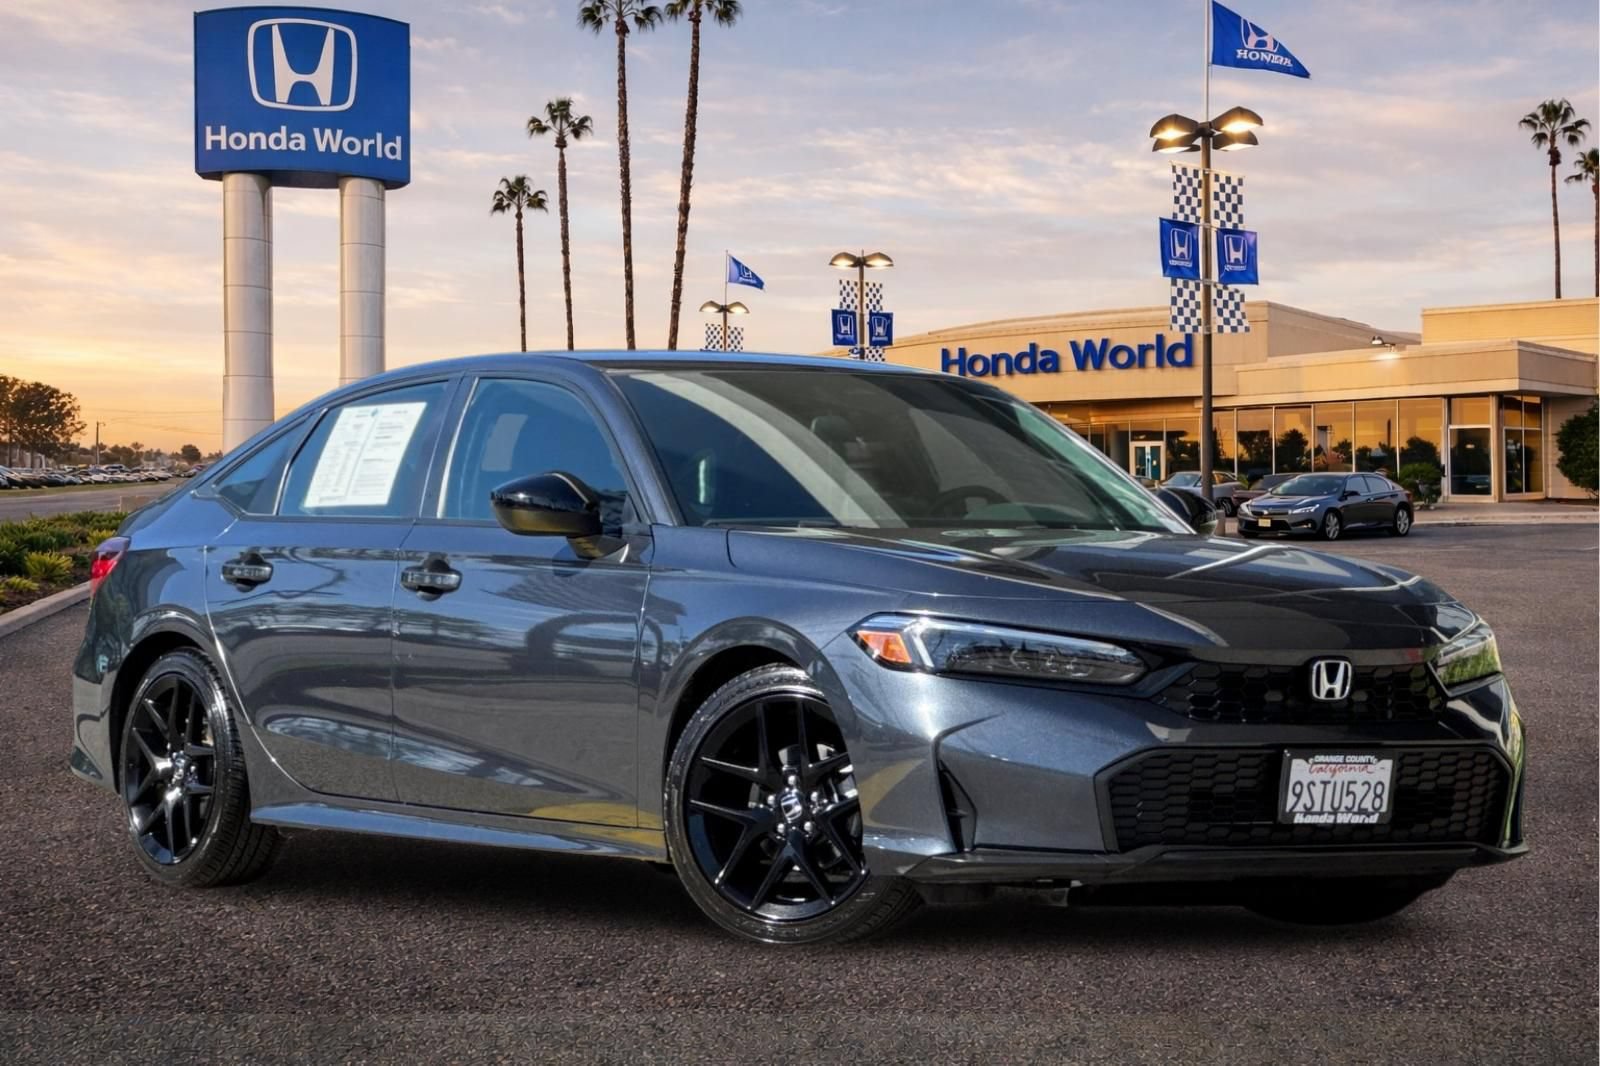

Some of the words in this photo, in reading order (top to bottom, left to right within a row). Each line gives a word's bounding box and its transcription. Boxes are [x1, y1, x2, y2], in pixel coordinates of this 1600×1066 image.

[205, 126, 306, 151] Honda
[313, 127, 402, 160] World
[941, 343, 1060, 377] Honda
[1069, 334, 1194, 371] World
[1314, 755, 1345, 763] ORANGE
[1346, 755, 1375, 763] COUNTY
[1289, 781, 1385, 813] 9STU528
[1293, 813, 1335, 824] Honda
[1336, 813, 1379, 824] World
